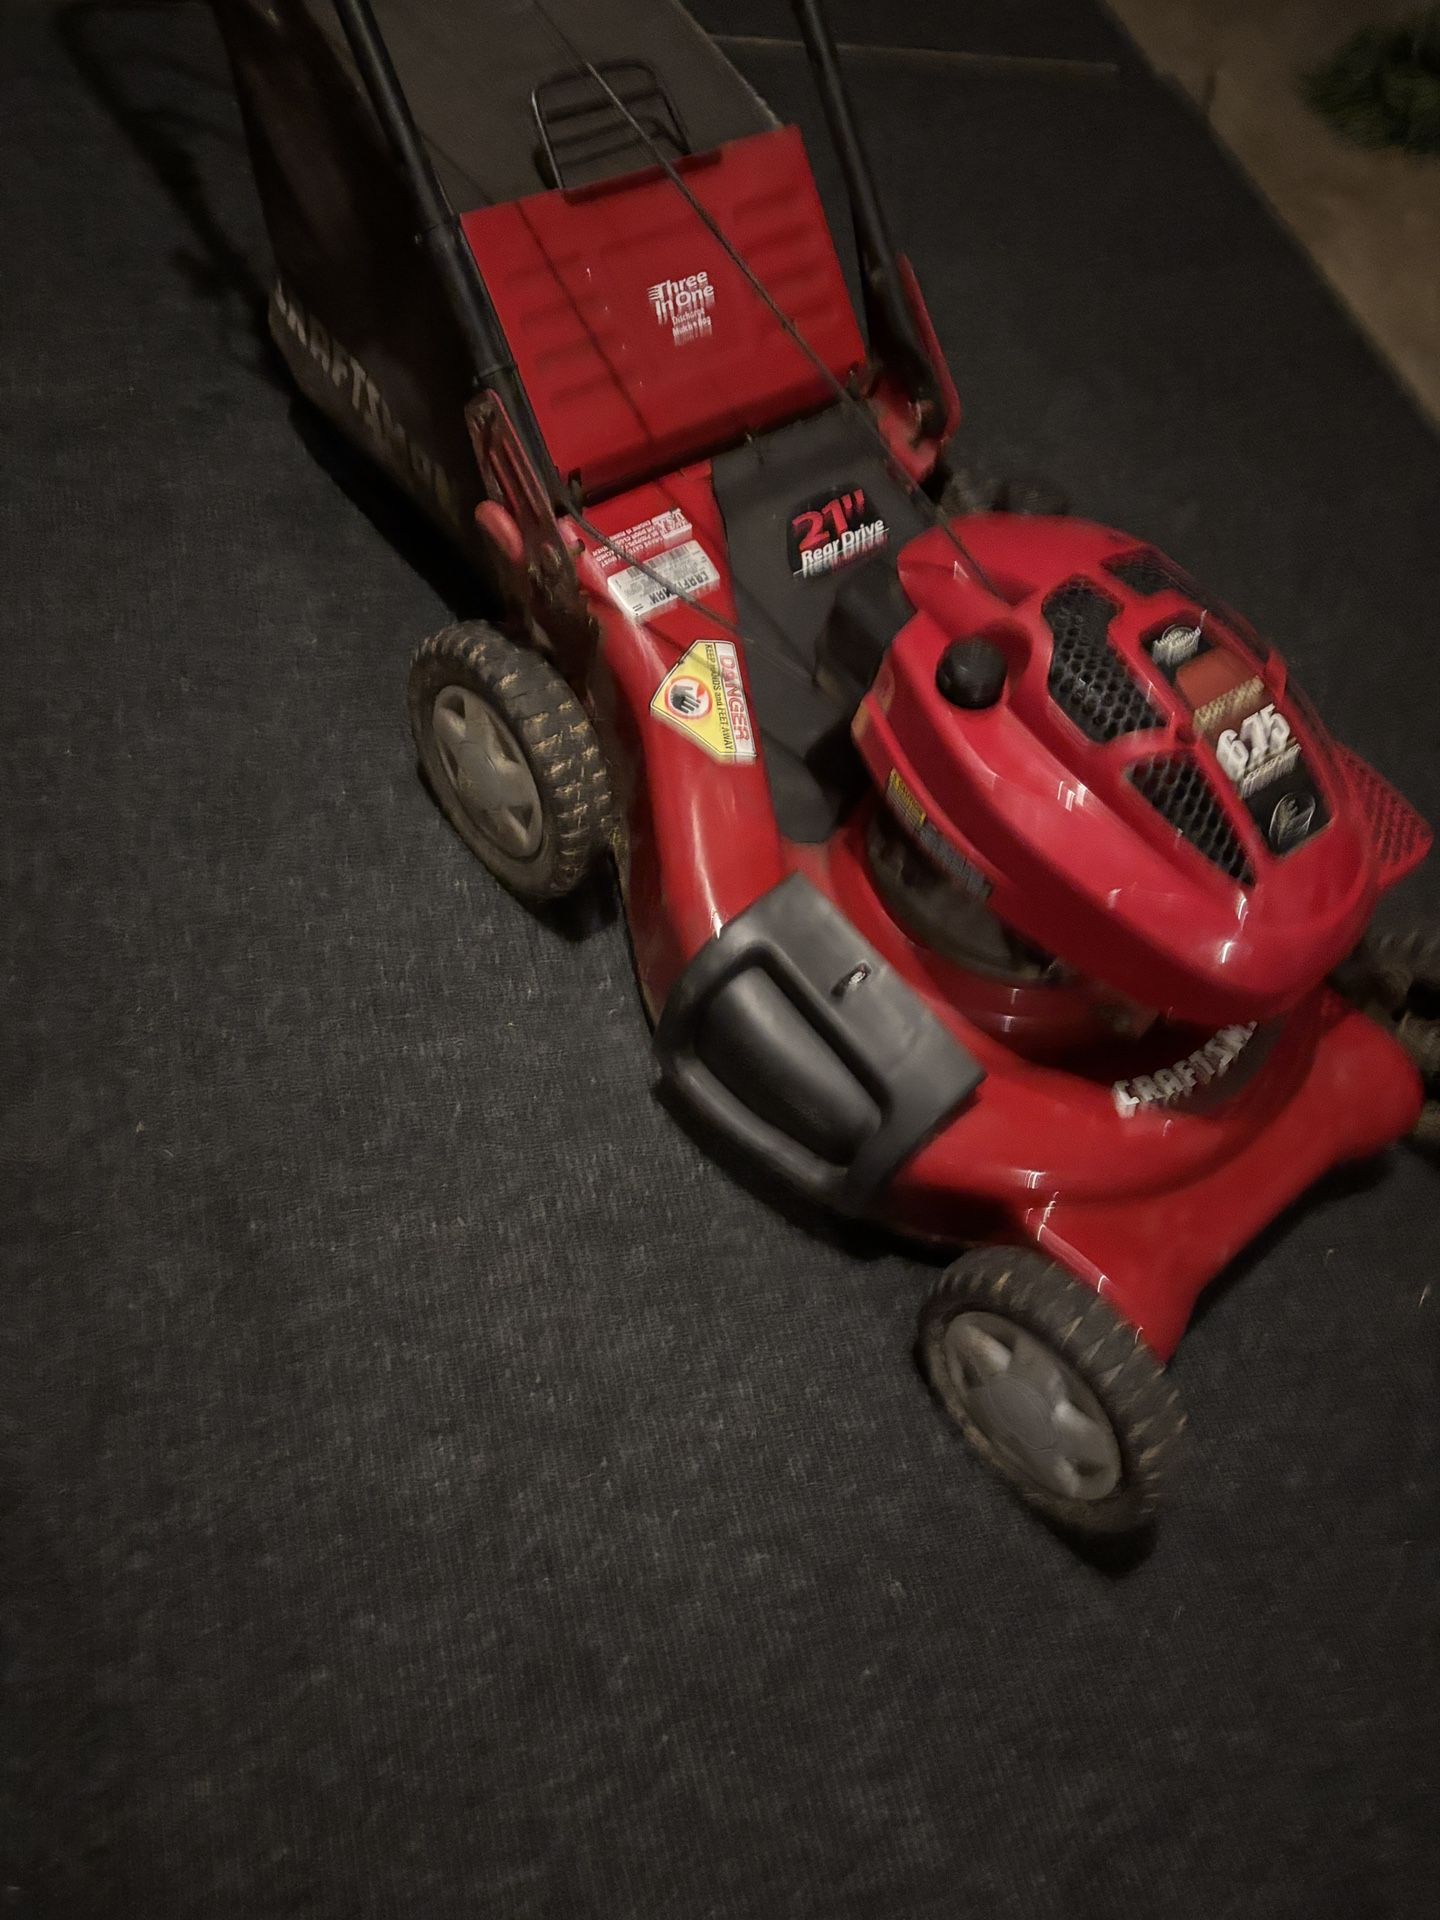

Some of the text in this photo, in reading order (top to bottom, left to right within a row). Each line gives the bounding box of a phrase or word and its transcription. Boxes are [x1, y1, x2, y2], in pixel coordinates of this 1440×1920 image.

[647, 271, 708, 301] Three
[655, 285, 714, 318] In One
[792, 489, 865, 551] 21"
[801, 519, 885, 568] Rear Drive
[705, 643, 717, 664] KEEP
[720, 655, 750, 741] DANGER
[718, 707, 729, 726] FEET
[721, 727, 734, 751] AWAY
